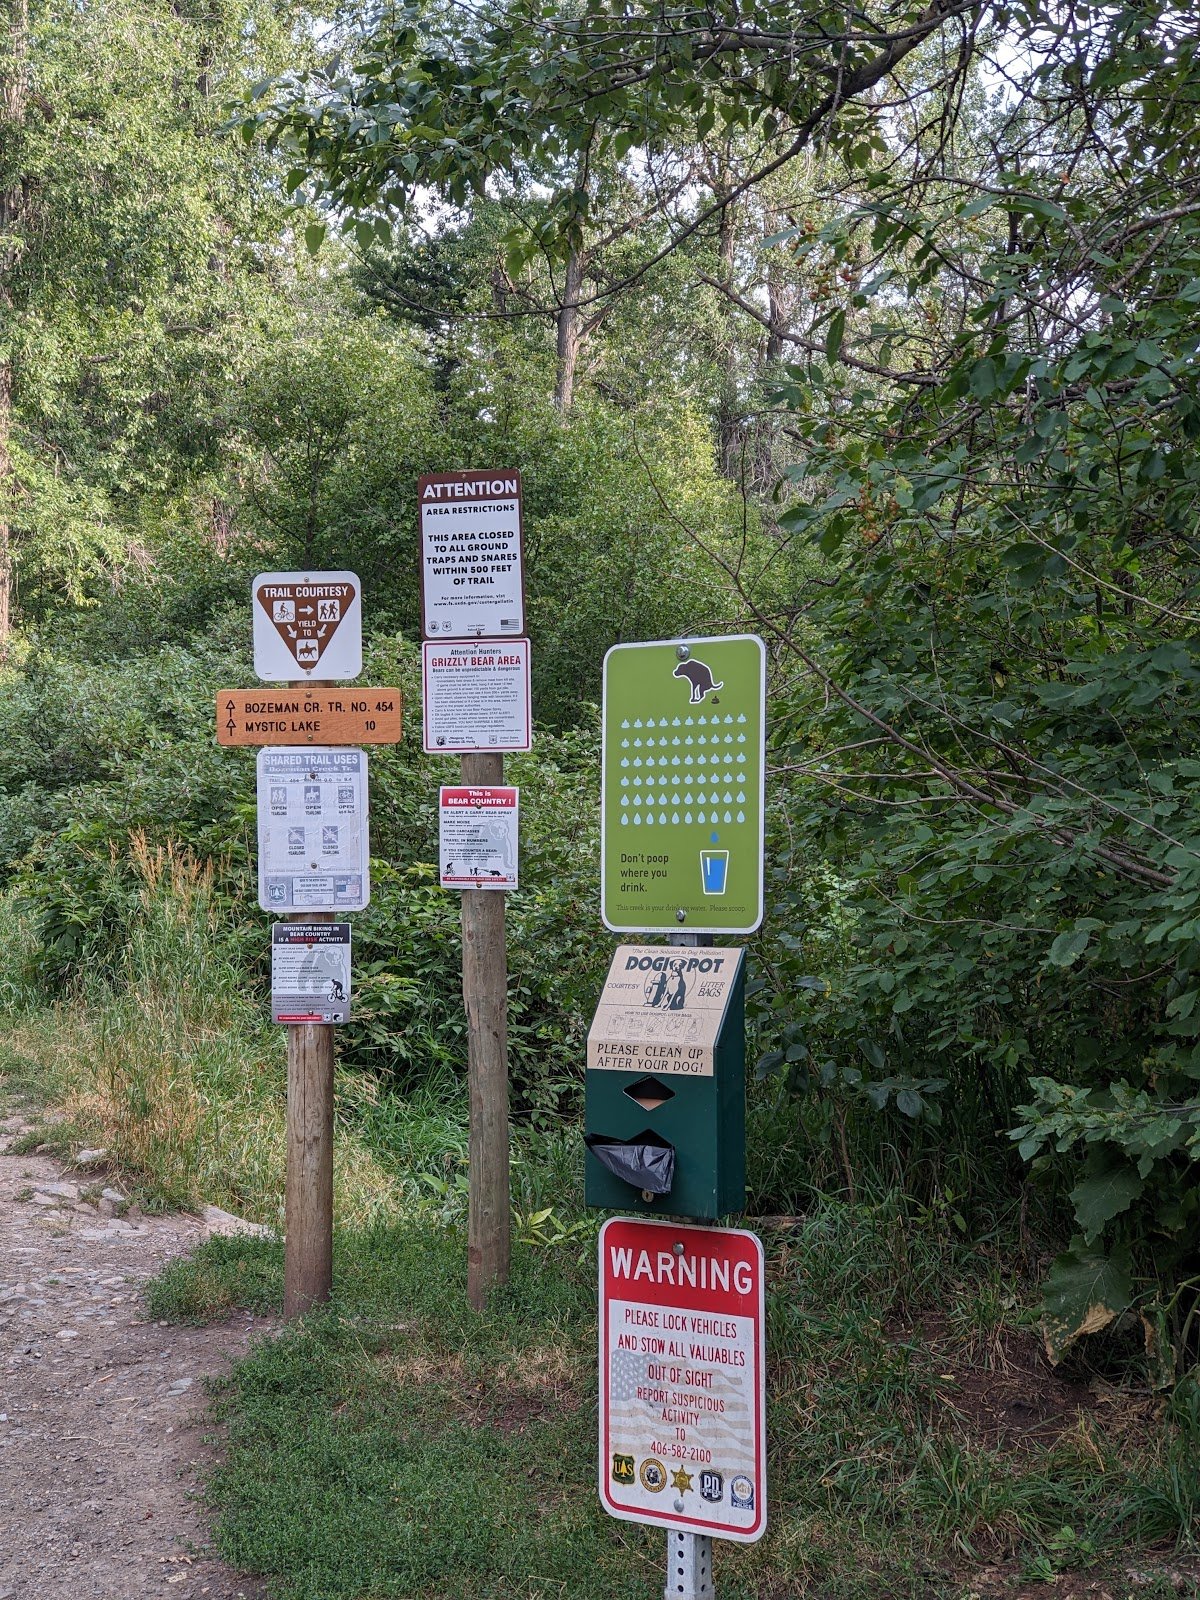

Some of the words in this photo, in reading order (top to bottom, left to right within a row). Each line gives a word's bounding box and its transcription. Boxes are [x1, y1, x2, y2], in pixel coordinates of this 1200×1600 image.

[423, 480, 516, 498] ATTENTION
[452, 504, 514, 514] RESTRICTIONS
[429, 534, 448, 542] THIS
[451, 533, 476, 541] AREA
[479, 531, 514, 539] CLOSED
[449, 544, 465, 552] ALL
[468, 543, 508, 551] GROUND
[481, 553, 517, 562] SNARES
[433, 567, 468, 575] WITHIN
[264, 588, 293, 597] TRAIL
[296, 586, 348, 597] COURTESY
[432, 658, 468, 666] GRIZZLY
[471, 657, 494, 665] BEAR
[498, 656, 521, 664] AREA
[245, 703, 299, 713] BOZEMAN
[304, 702, 323, 712] CR.
[328, 702, 345, 712] TR.
[351, 702, 370, 712] NO.
[376, 702, 393, 711] 454
[246, 722, 287, 732] MYSTIC
[292, 721, 320, 731] LAKE
[365, 721, 375, 730] 10
[265, 756, 302, 765] SHARED
[304, 755, 331, 764] TRAIL
[334, 755, 357, 764] USES
[621, 854, 644, 862] Don’t
[647, 855, 669, 864] poop
[621, 869, 648, 877] where
[652, 870, 667, 879] you
[621, 883, 647, 892] drink.
[698, 988, 721, 997] BAGS
[598, 1044, 639, 1055] PLEASE
[646, 1046, 682, 1057] CLEAN
[688, 1048, 703, 1058] UP
[597, 1057, 632, 1068] AFTER
[638, 1059, 668, 1070] YOUR
[674, 1062, 704, 1072] DOG!
[610, 1246, 752, 1295] WARNING
[625, 1308, 658, 1328] PLEASE
[663, 1314, 687, 1332] LOCK
[691, 1317, 737, 1339] VEHICLES
[618, 1334, 638, 1350] AND
[641, 1337, 665, 1354] STOW
[668, 1341, 686, 1358] ALL
[689, 1344, 745, 1366] VALUABLES
[648, 1365, 666, 1381] OUT
[670, 1367, 682, 1383] OF
[685, 1369, 713, 1388] SIGHT
[637, 1387, 669, 1403] REPORT
[672, 1392, 725, 1413] SUSPICIOUS
[662, 1409, 699, 1426] ACTIVITY
[676, 1428, 686, 1440] TO
[651, 1440, 711, 1462] 406-582-2100
